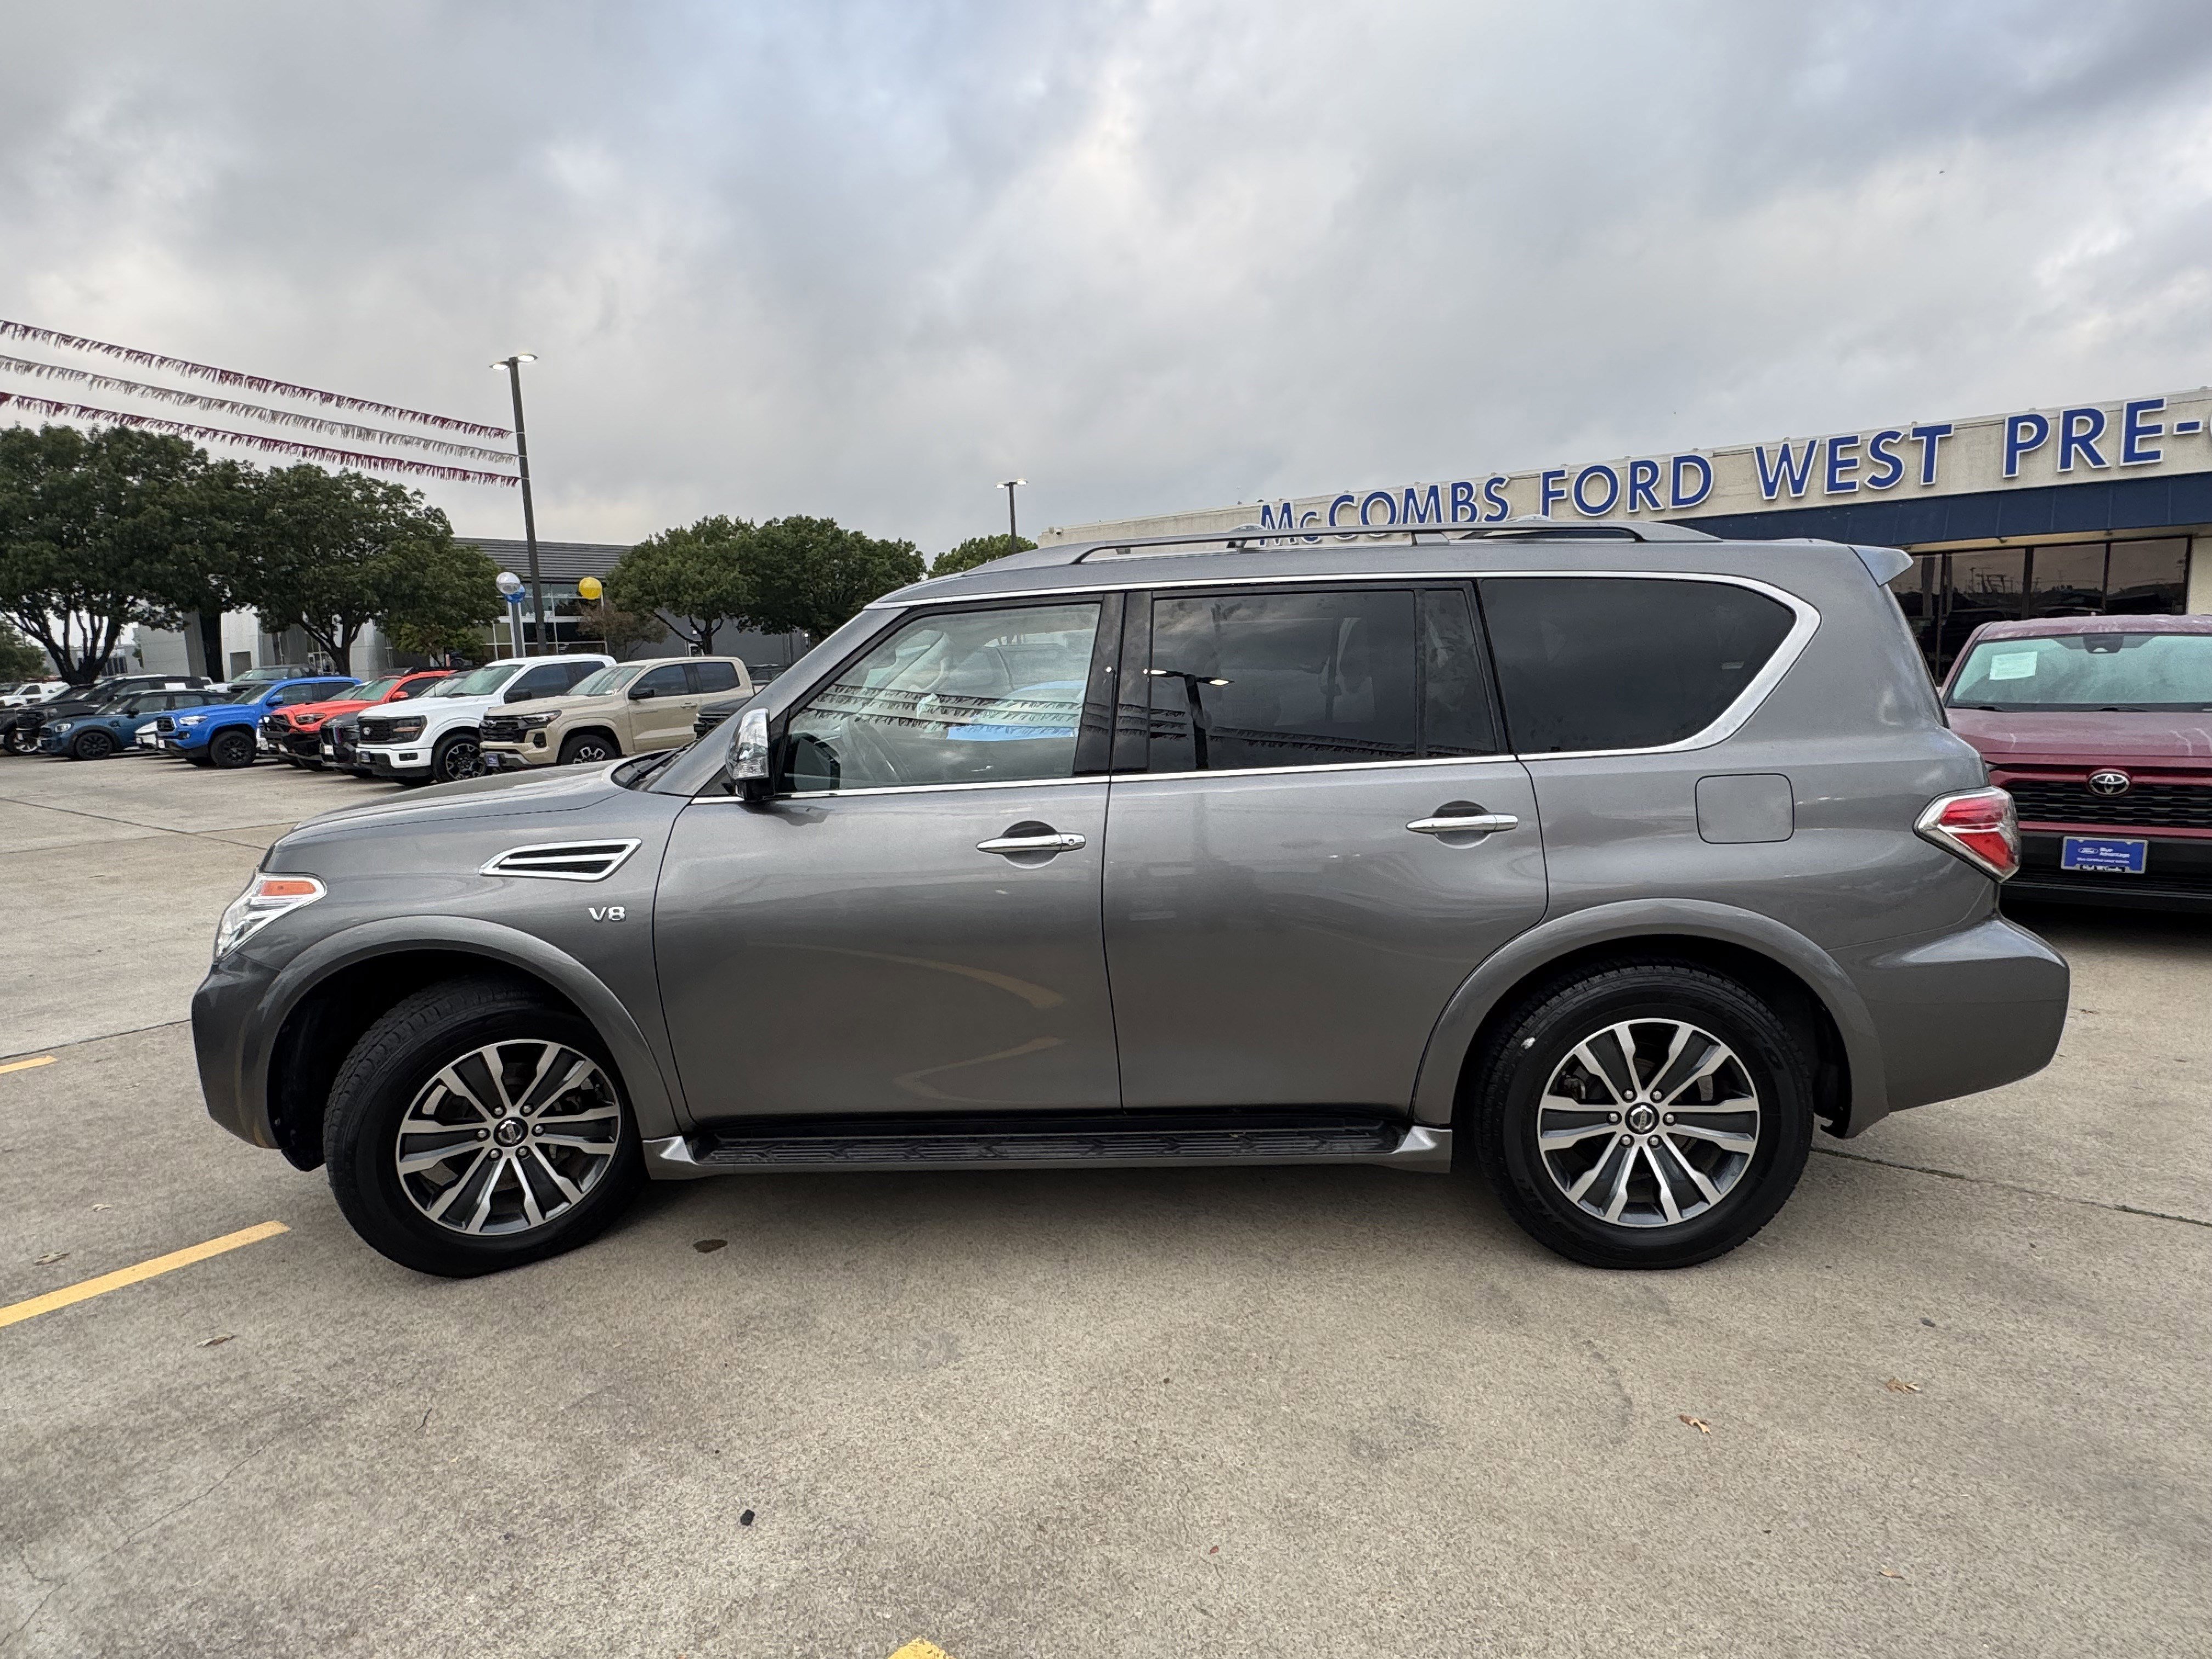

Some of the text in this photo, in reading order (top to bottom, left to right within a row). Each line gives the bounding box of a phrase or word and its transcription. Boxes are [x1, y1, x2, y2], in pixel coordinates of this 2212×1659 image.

[1540, 454, 1716, 517] FORD
[1754, 423, 1954, 500] WEST
[2002, 397, 2212, 478] PRE-
[588, 906, 626, 922] V8
